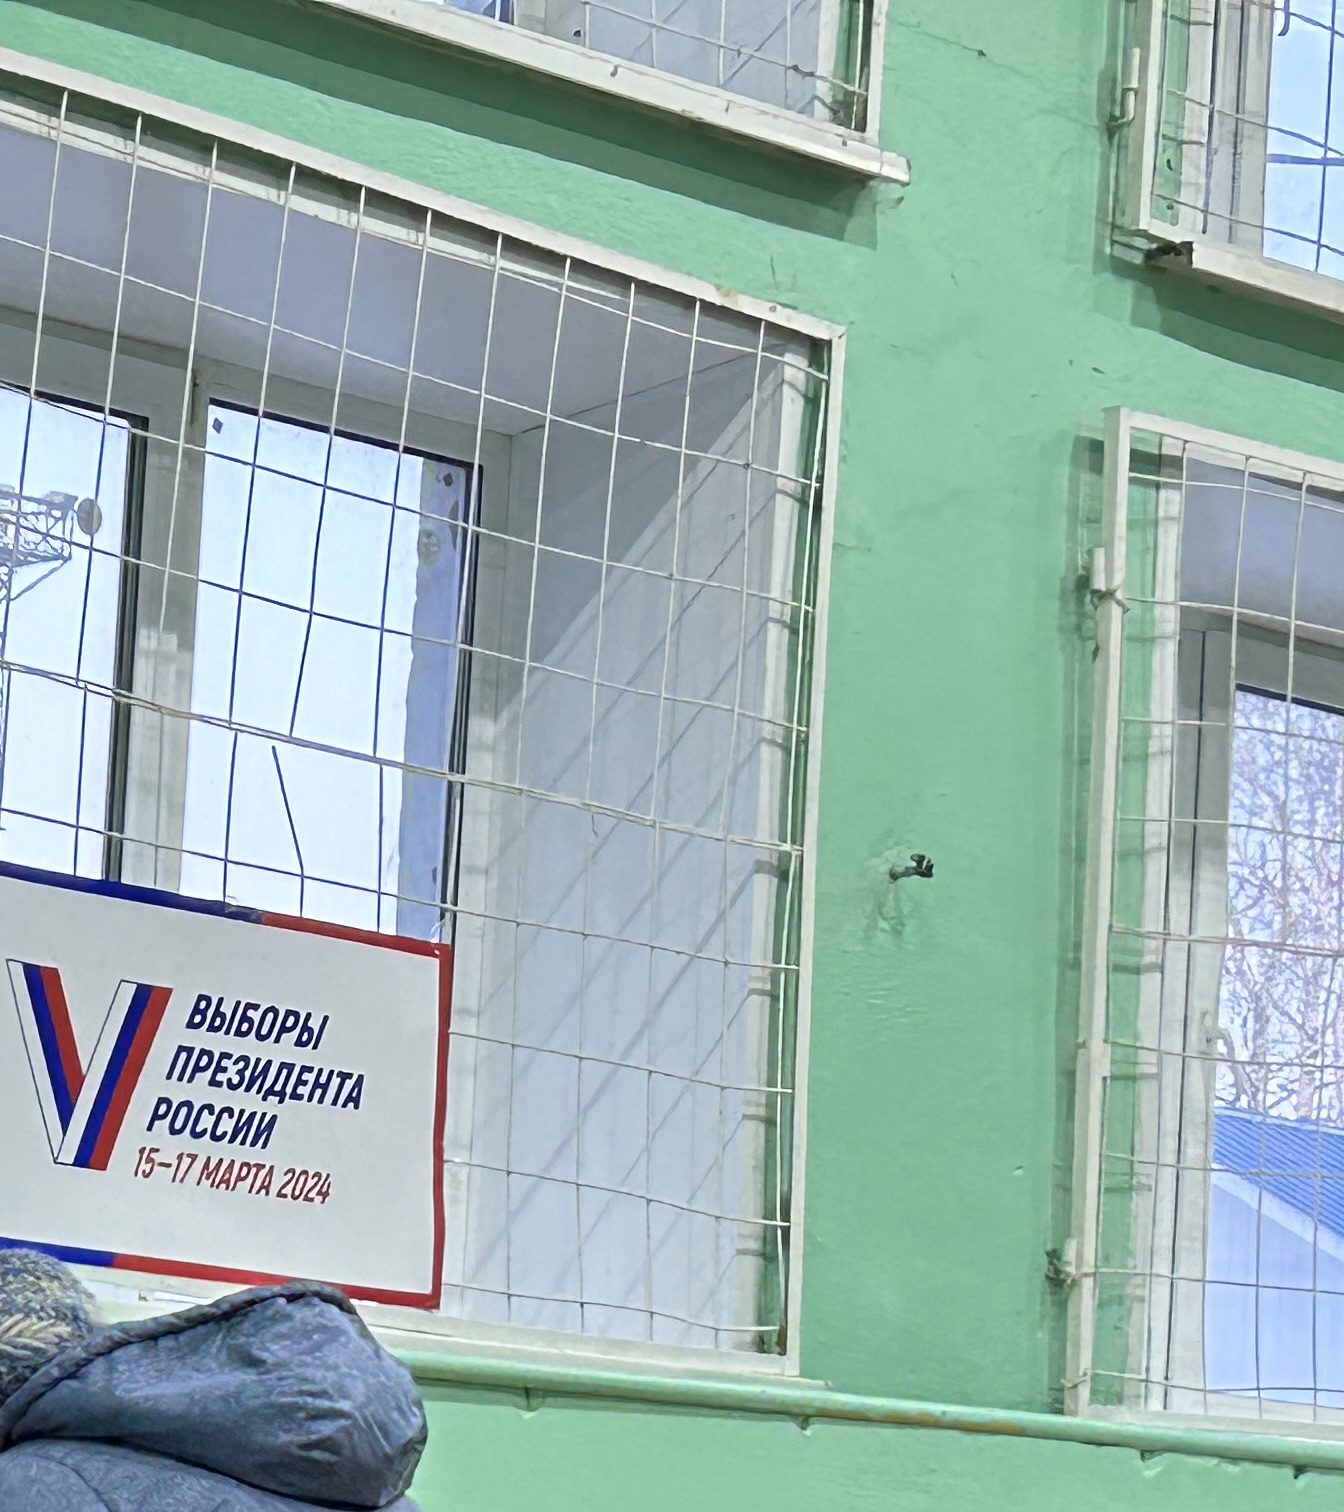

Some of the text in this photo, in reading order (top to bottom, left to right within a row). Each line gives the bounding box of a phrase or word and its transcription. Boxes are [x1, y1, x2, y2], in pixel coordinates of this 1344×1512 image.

[185, 994, 330, 1050] ВЫБОРЫ
[166, 1045, 366, 1110] ПРЕЗИДЕНТА
[146, 1096, 279, 1150] РОССИИ
[196, 1154, 272, 1197] МАРТА
[276, 1168, 332, 1204] 2024
